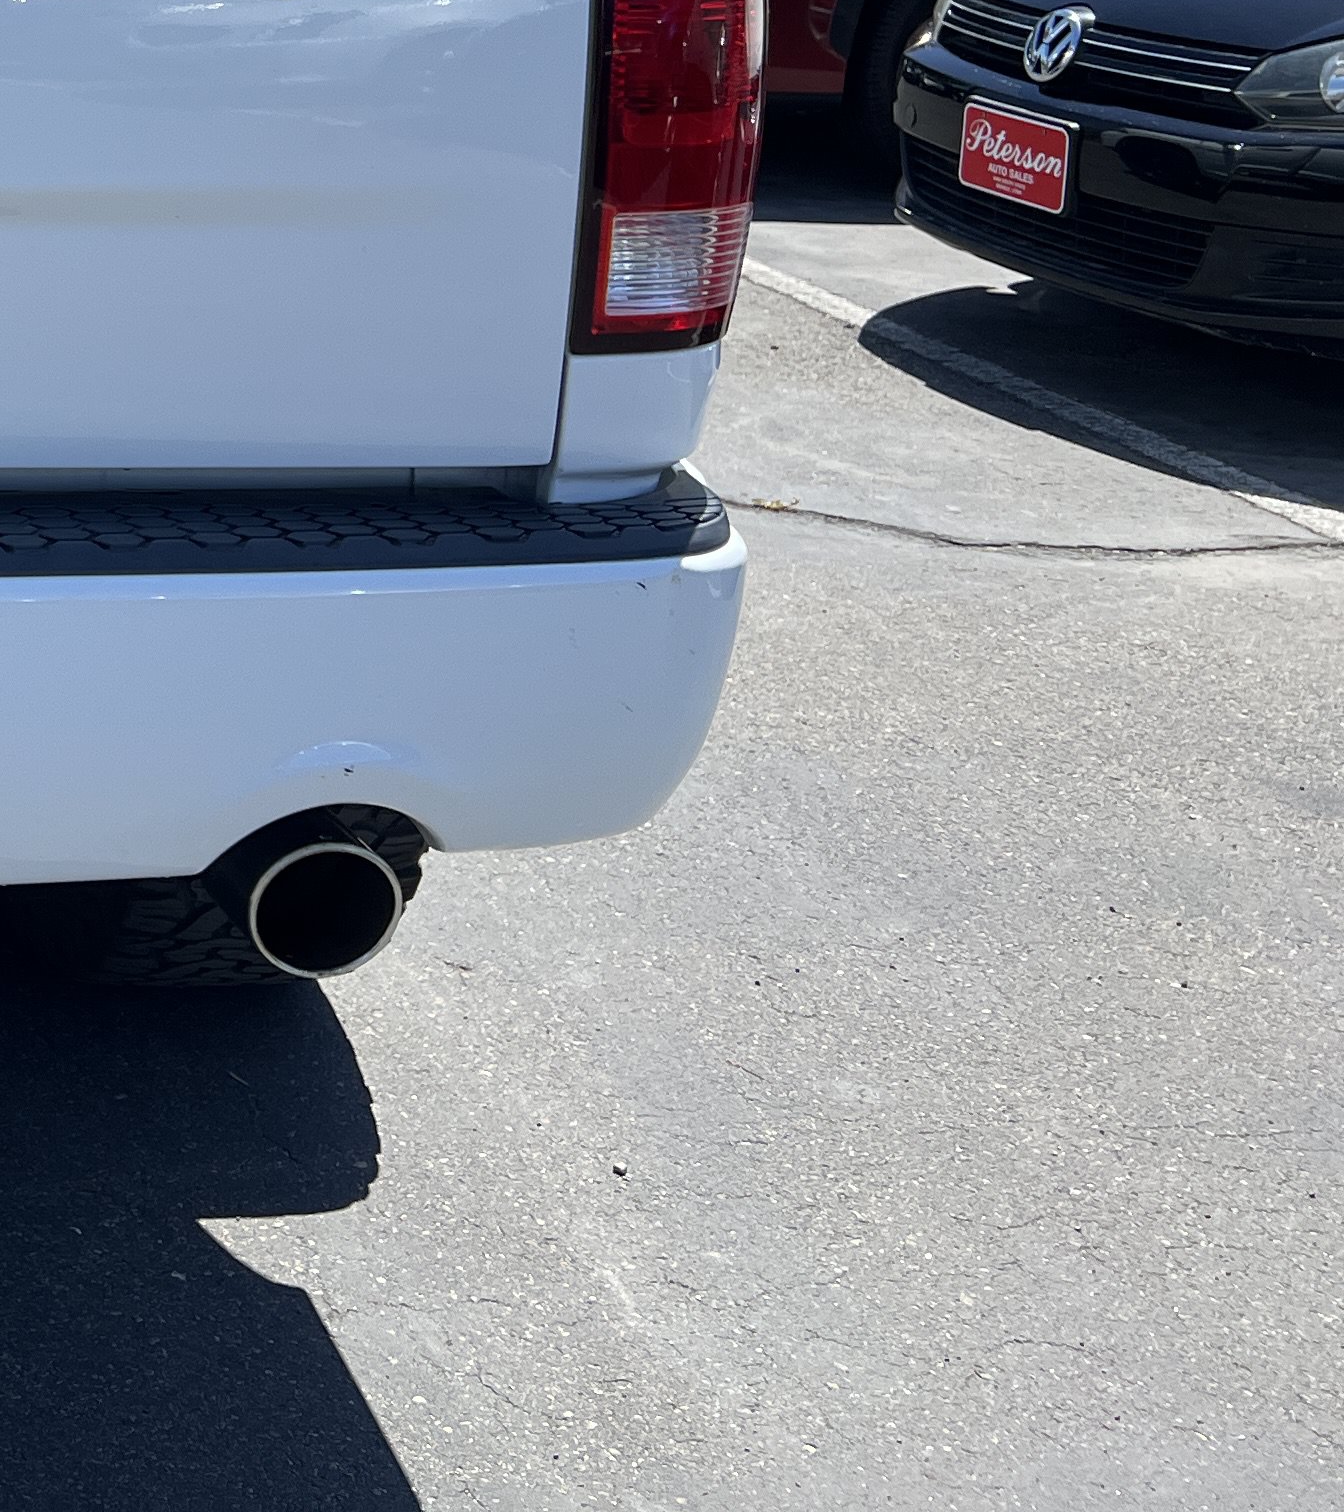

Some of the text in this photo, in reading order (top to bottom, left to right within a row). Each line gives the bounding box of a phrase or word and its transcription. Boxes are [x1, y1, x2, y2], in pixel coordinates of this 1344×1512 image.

[966, 118, 1062, 178] Peterson
[987, 162, 1008, 177] AUTO
[1008, 168, 1034, 185] SALES
